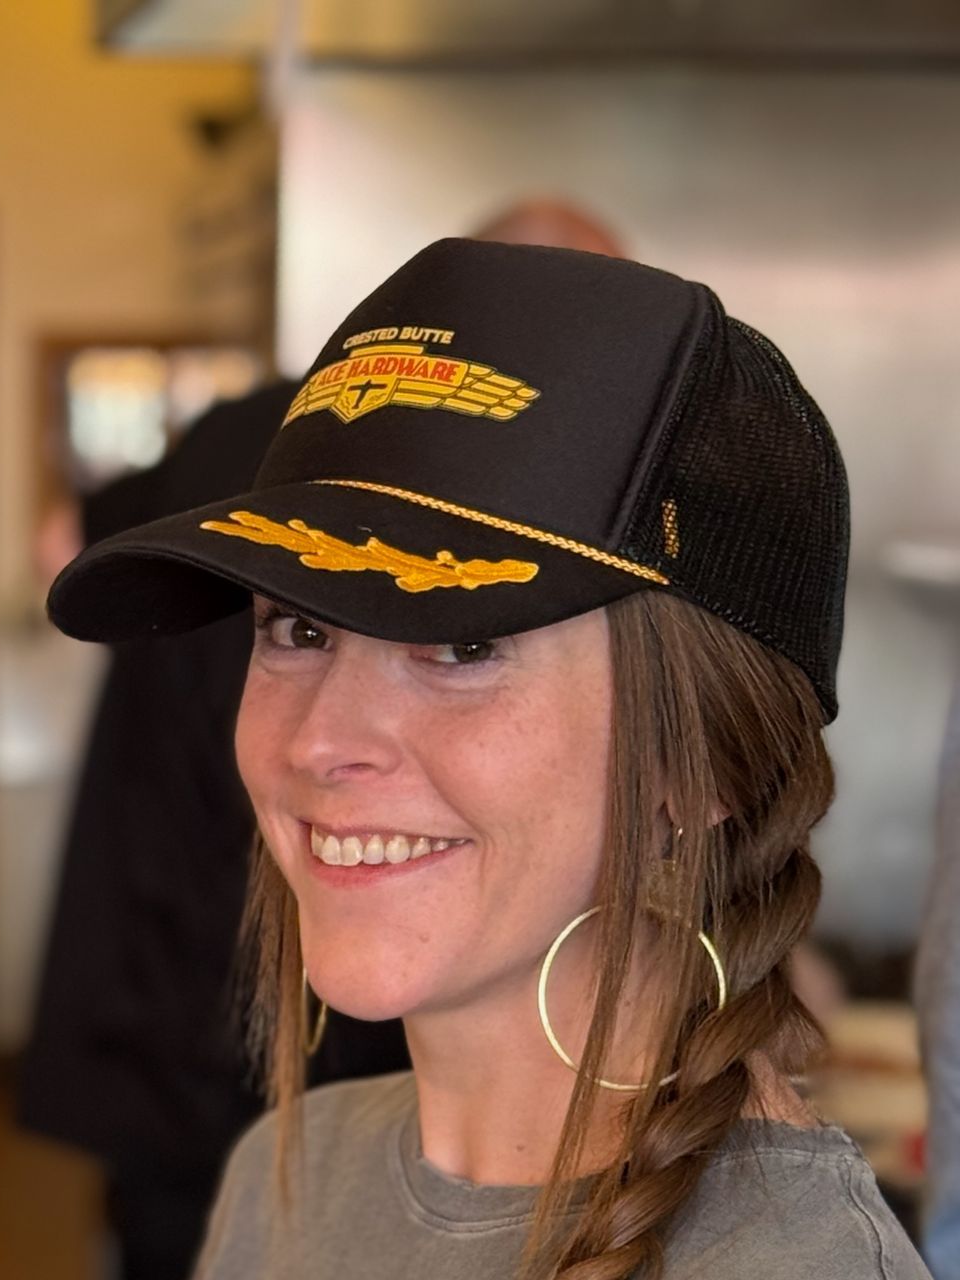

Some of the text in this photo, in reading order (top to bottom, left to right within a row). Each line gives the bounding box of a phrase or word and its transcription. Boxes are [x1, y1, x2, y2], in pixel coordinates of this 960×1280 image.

[343, 326, 455, 349] CRESTED BUTTE
[346, 357, 460, 383] HARDWARE
